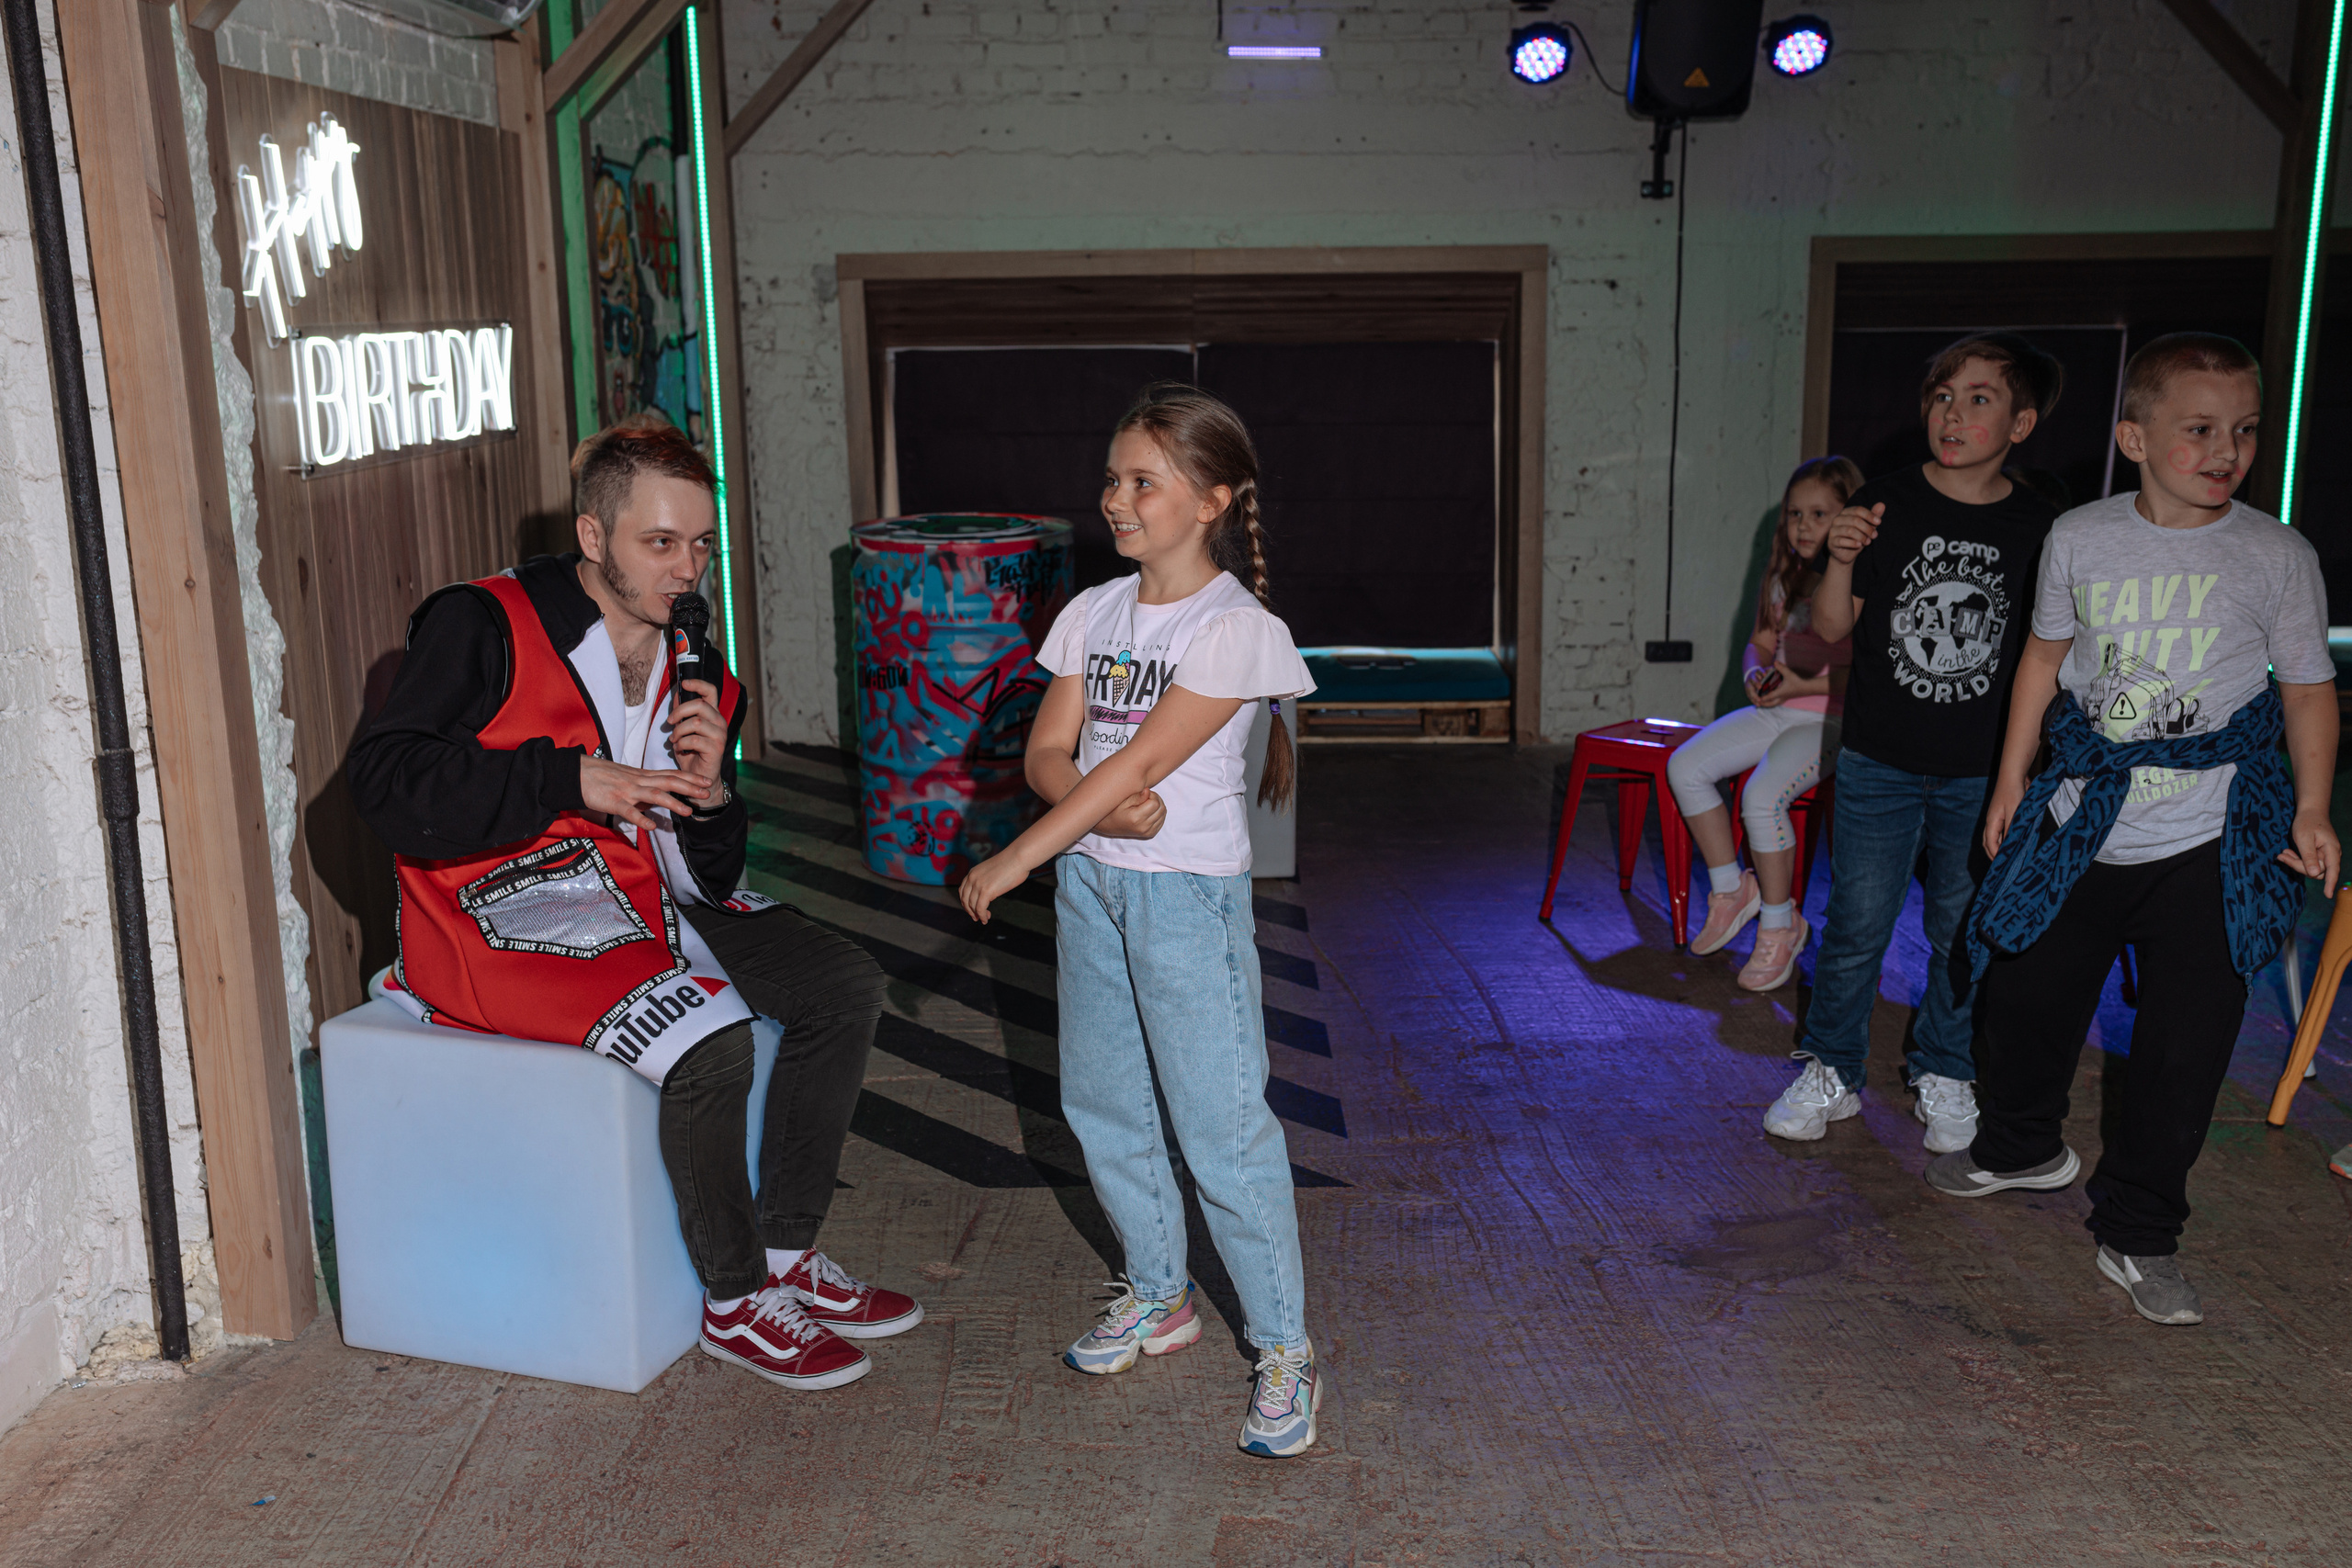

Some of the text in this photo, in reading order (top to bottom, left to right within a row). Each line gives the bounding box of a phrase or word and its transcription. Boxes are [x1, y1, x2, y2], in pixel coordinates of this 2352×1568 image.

[303, 327, 513, 466] BIRTHDAY
[1947, 540, 2000, 566] camp
[1902, 556, 2005, 592] The best
[1892, 607, 2005, 647] CAMP
[1938, 646, 1980, 668] in the
[1894, 661, 1990, 704] WORLD
[1090, 723, 1129, 745] loadin
[2124, 773, 2199, 805] ULLDOZER
[488, 861, 515, 879] SMILE
[517, 852, 544, 867] SMILE
[545, 842, 569, 858] SMILE
[591, 849, 608, 874] SMILE
[484, 884, 514, 904] SMILE
[514, 874, 545, 890] SMILE
[508, 940, 537, 952] SMILE
[538, 944, 569, 955] SMILE
[628, 979, 654, 1003] SMILE
[602, 999, 628, 1026] SMILE
[605, 986, 706, 1069] uTube
